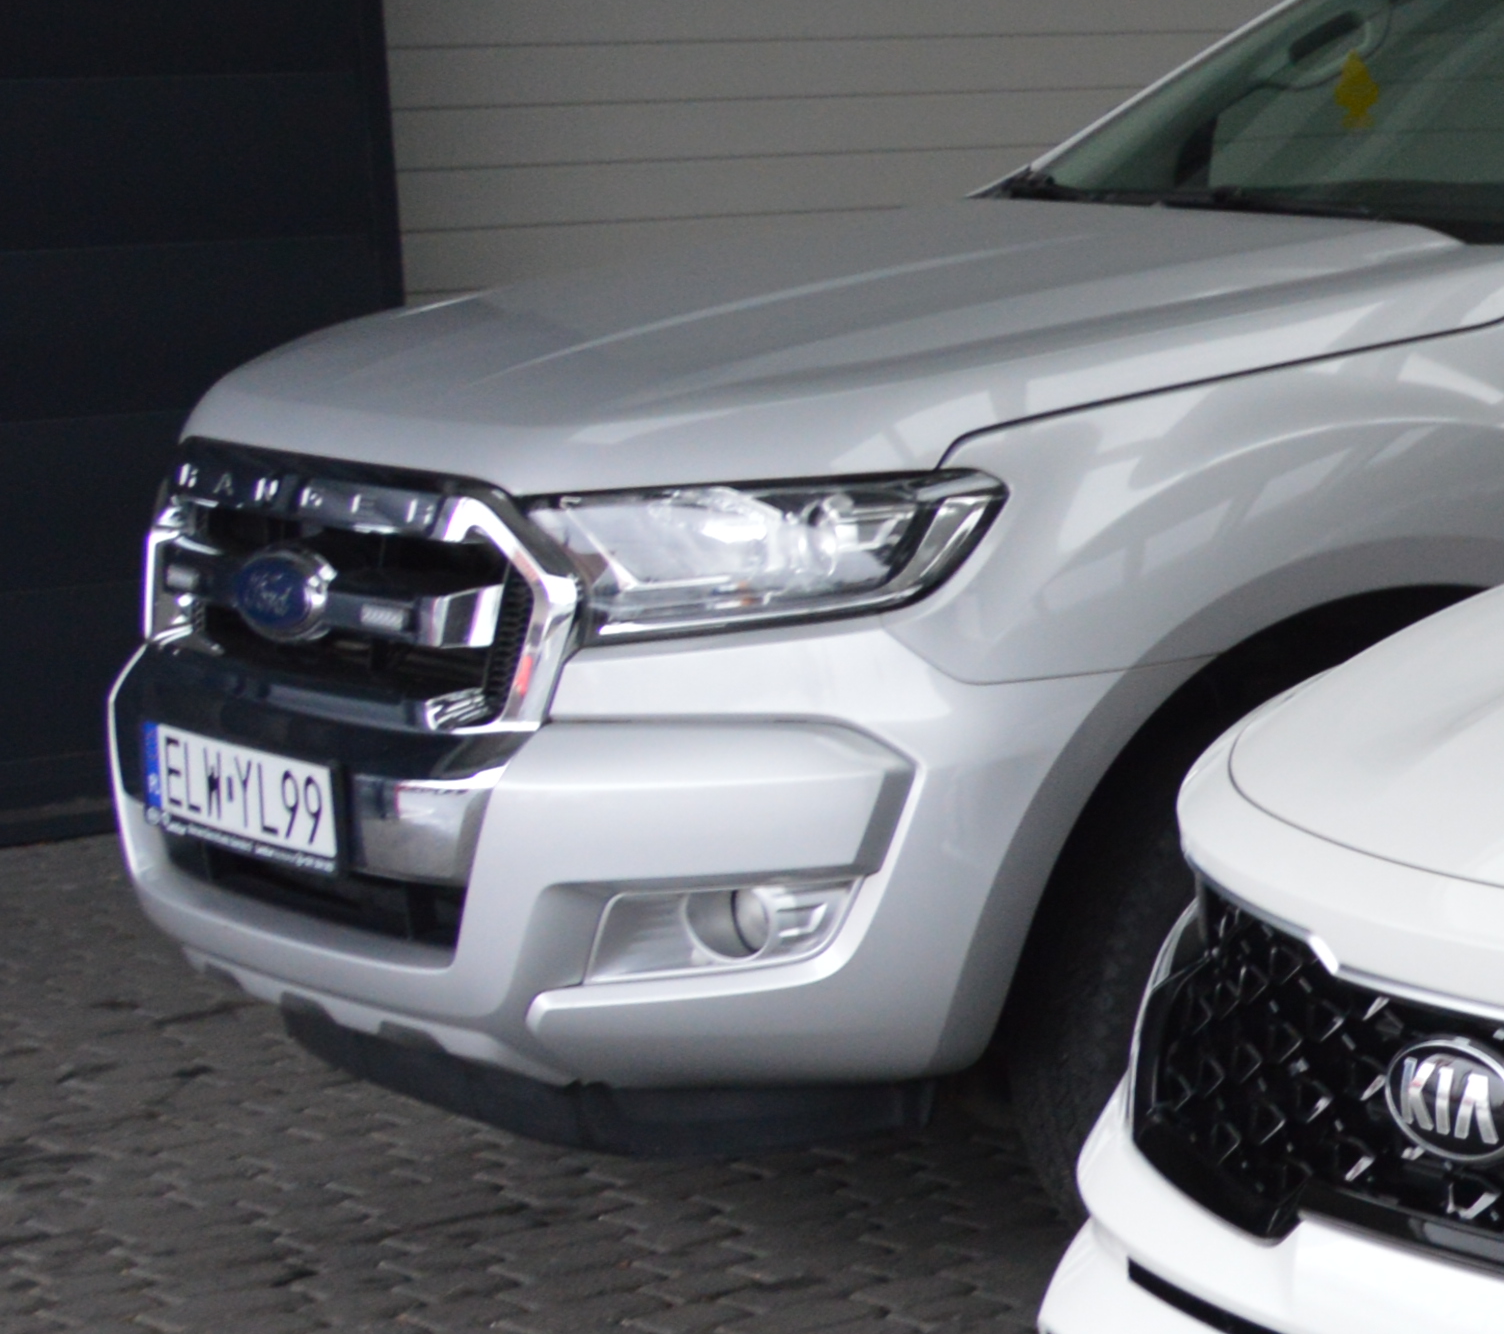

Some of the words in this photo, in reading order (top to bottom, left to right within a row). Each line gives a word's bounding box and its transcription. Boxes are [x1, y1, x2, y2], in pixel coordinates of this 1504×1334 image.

[165, 736, 221, 821] ELW
[234, 755, 322, 845] YL99
[1401, 1056, 1500, 1145] KIA
